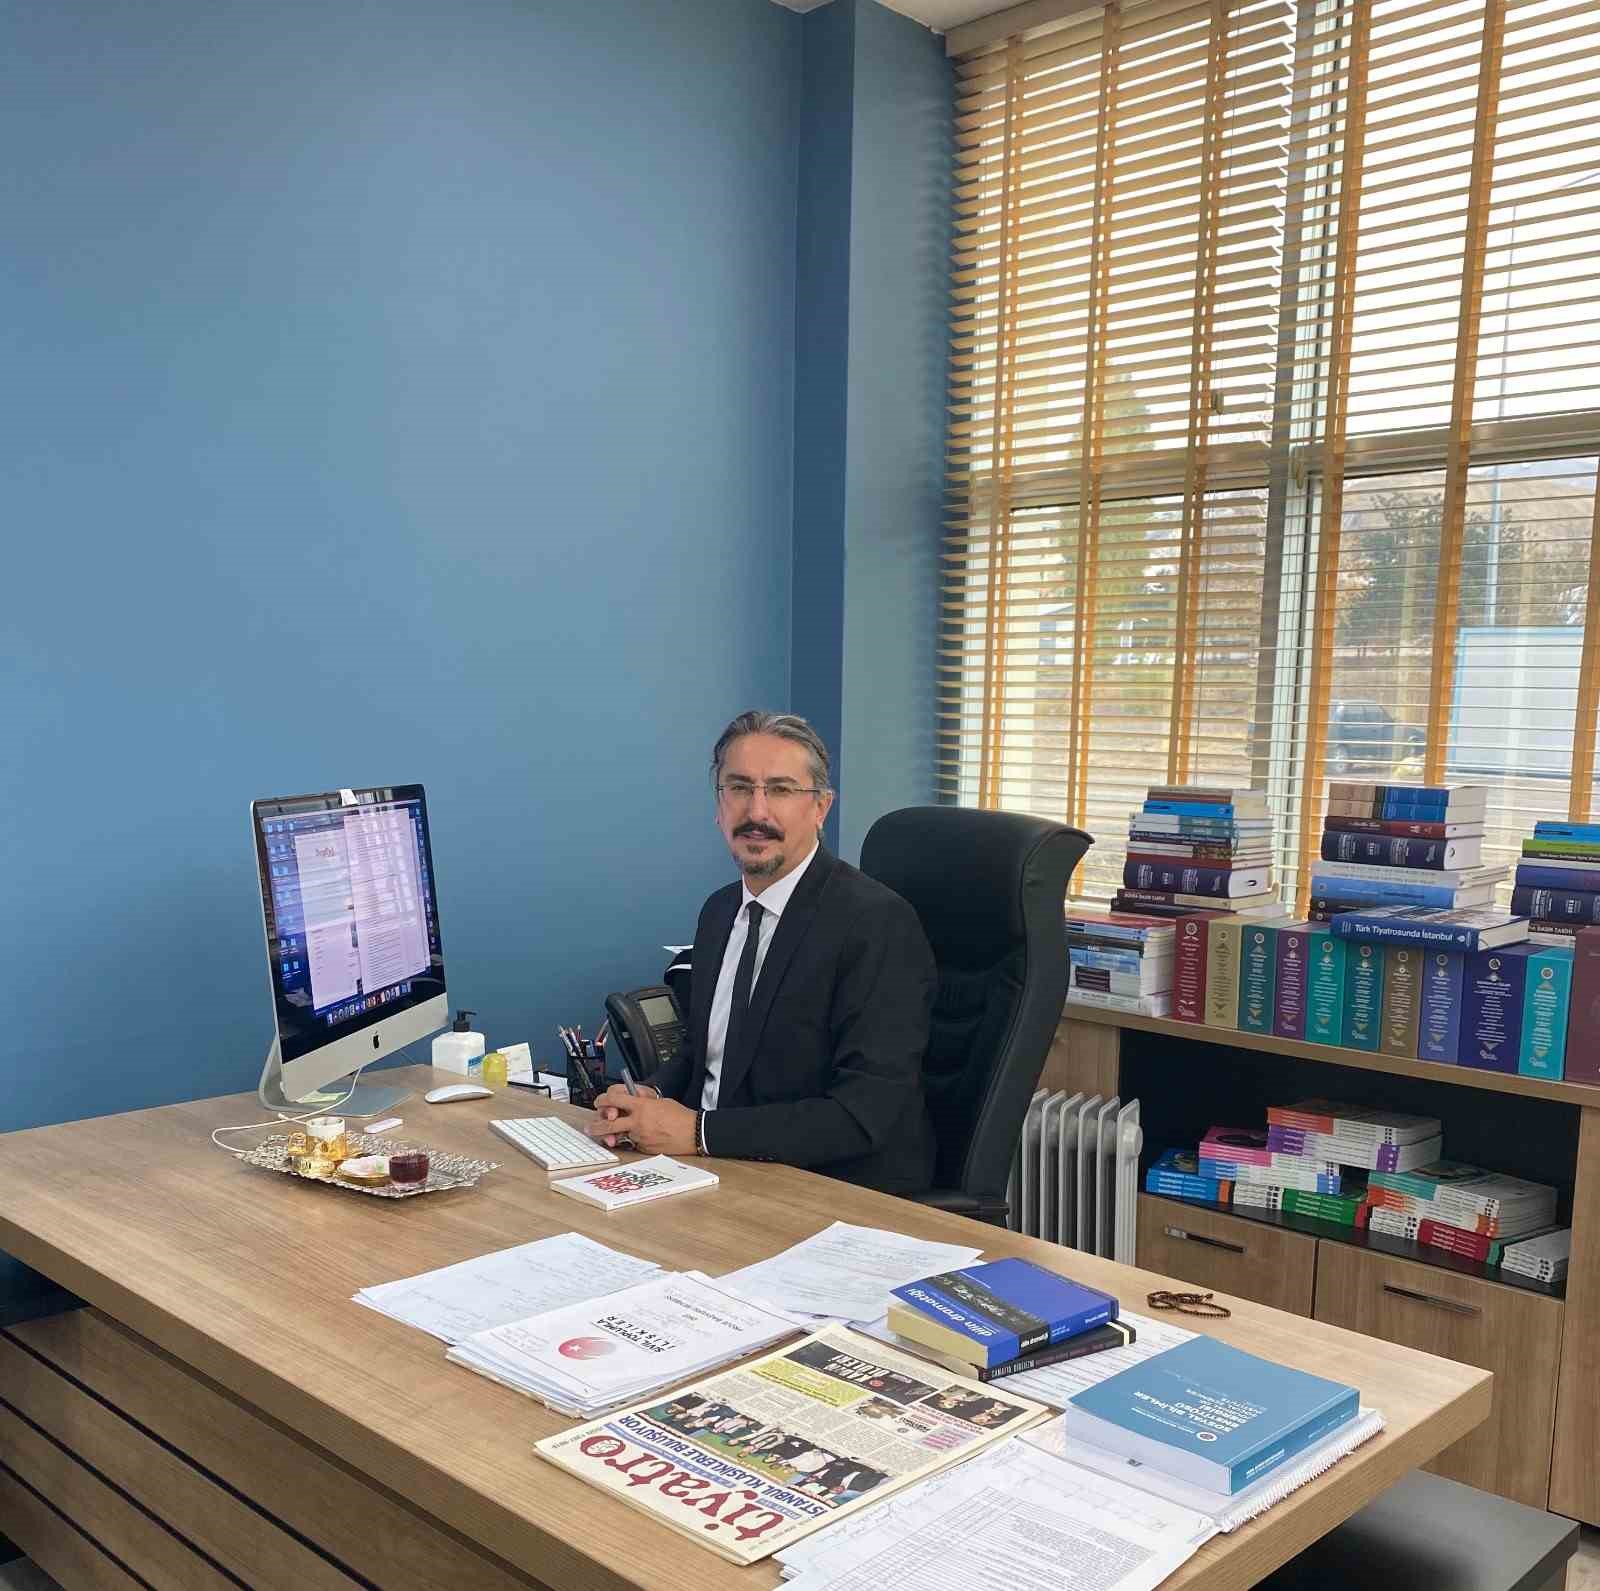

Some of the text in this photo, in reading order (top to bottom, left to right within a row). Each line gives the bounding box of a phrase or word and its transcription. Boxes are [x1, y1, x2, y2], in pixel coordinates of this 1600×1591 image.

[963, 1321, 993, 1337] dilin
[616, 1415, 690, 1451] BULUŞUYOR
[680, 1448, 766, 1488] KLASİKLERLE
[580, 1436, 783, 1539] tiyatro
[757, 1484, 829, 1517] İSTANBUL
